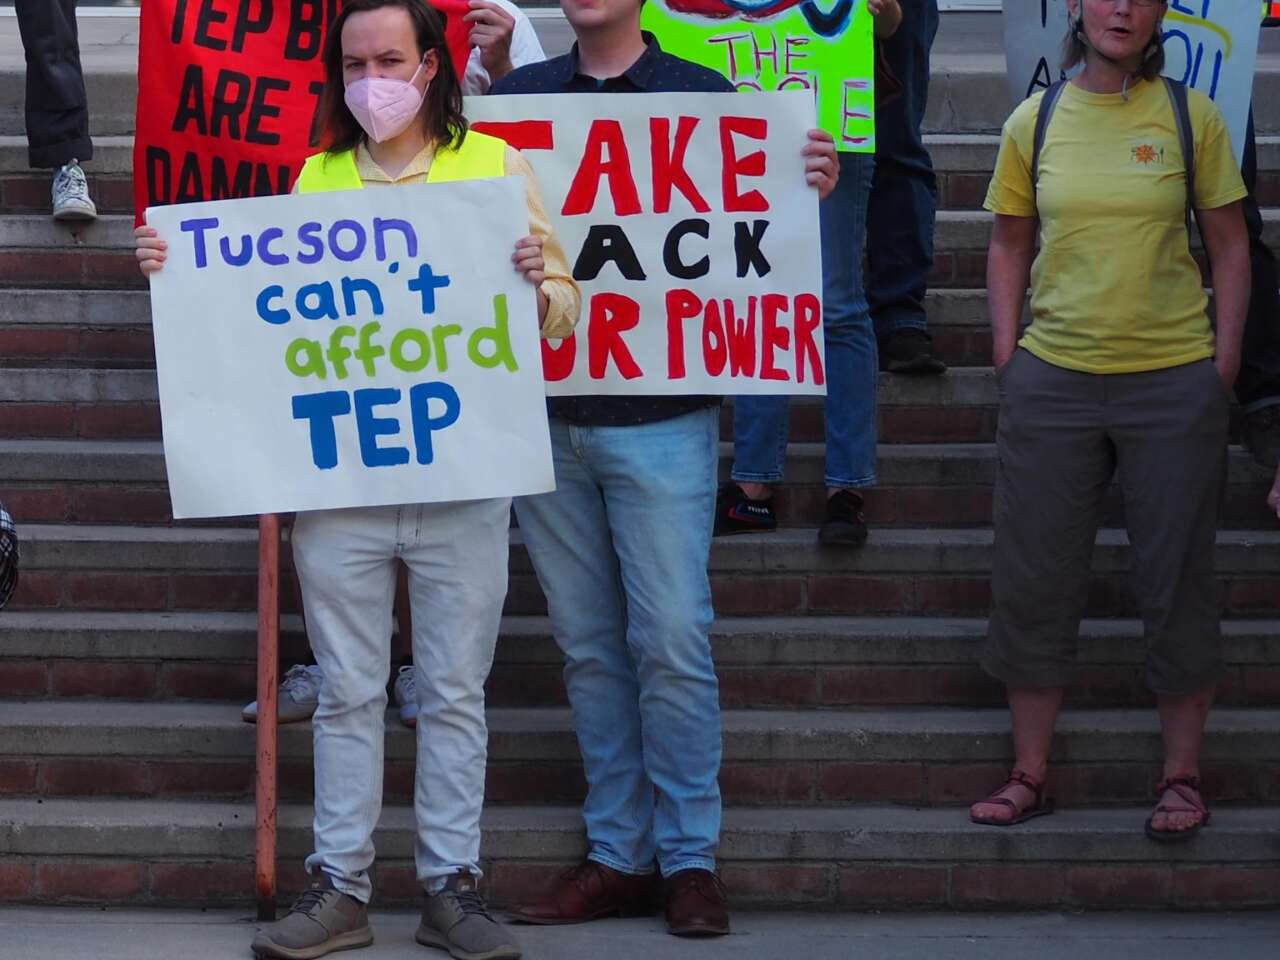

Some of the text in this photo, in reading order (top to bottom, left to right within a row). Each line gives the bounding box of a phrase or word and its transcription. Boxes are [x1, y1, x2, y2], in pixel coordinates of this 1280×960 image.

[708, 31, 811, 81] THE
[172, 63, 290, 146] ARE
[180, 217, 418, 268] Tucson
[572, 218, 771, 281] ACK
[256, 262, 451, 325] can't
[285, 293, 520, 381] afford
[665, 289, 825, 385] POWER
[291, 381, 461, 471] TEP
